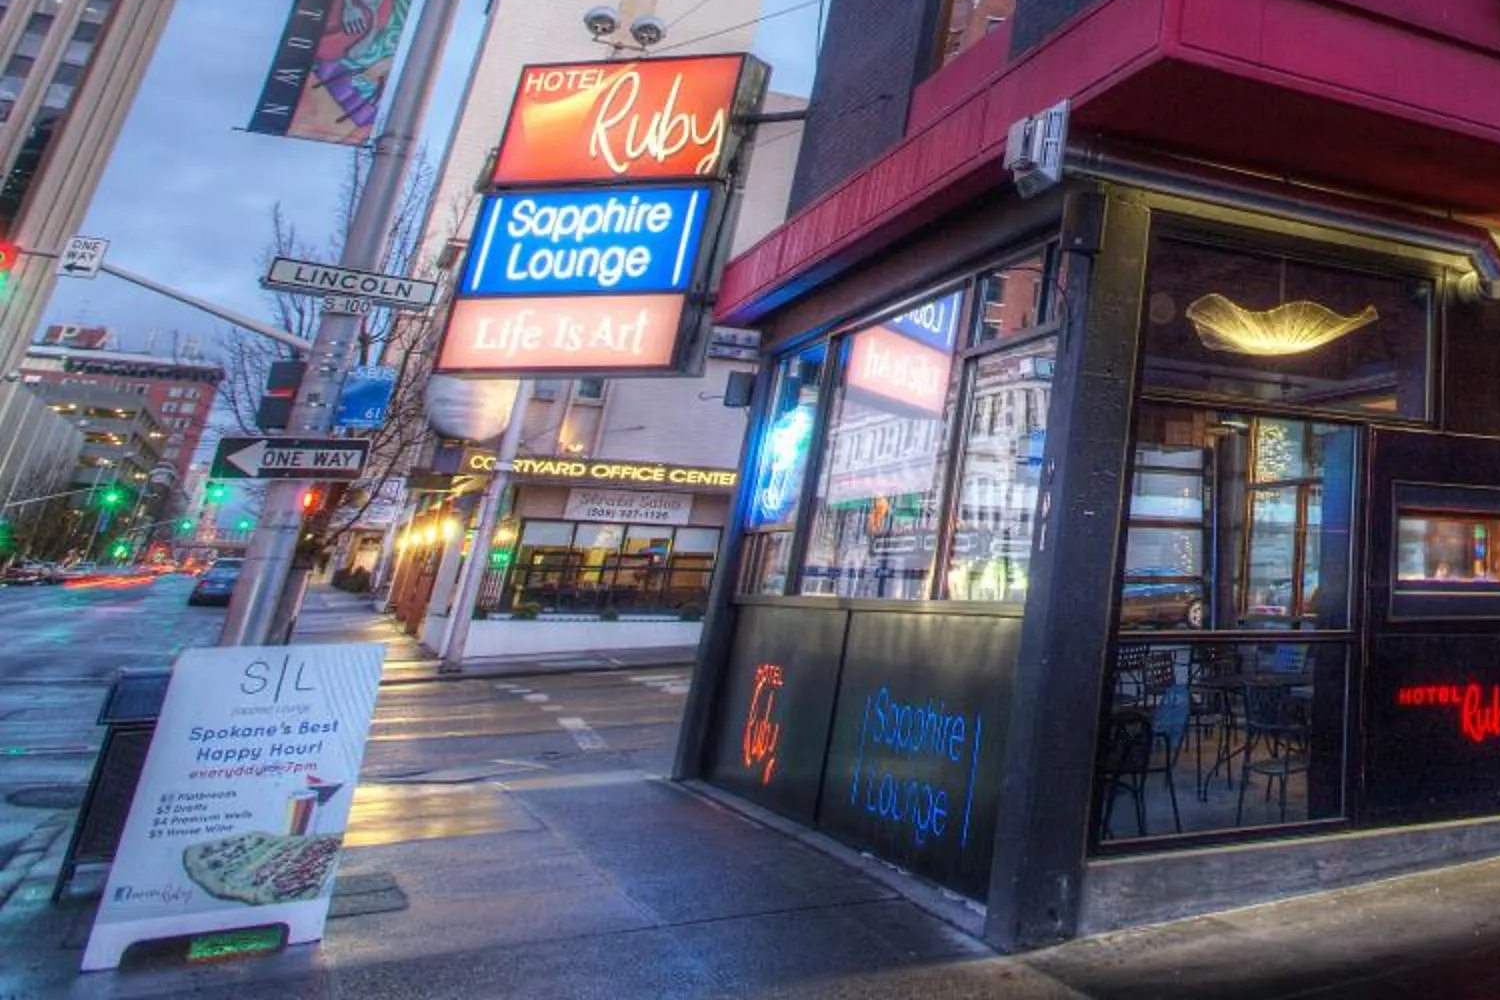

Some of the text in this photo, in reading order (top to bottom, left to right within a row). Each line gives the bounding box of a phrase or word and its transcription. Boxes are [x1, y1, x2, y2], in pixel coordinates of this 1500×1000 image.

[524, 68, 607, 93] HOTEL
[588, 70, 724, 175] Ruby
[506, 197, 673, 243] Sapphire
[66, 250, 97, 262] WAY
[70, 239, 101, 252] ONE
[505, 242, 652, 287] Lounge
[294, 266, 414, 298] LINCOLN
[472, 308, 650, 357] Life Is Art
[262, 450, 359, 467] ONE WAY
[469, 455, 586, 478] CORTYARD
[591, 464, 665, 482] OFFICE
[1396, 685, 1461, 705] HOTEL
[188, 719, 339, 743] Spokane's Best
[872, 686, 966, 762] Sapphire
[195, 746, 263, 763] Happy
[866, 767, 948, 847] Lounge
